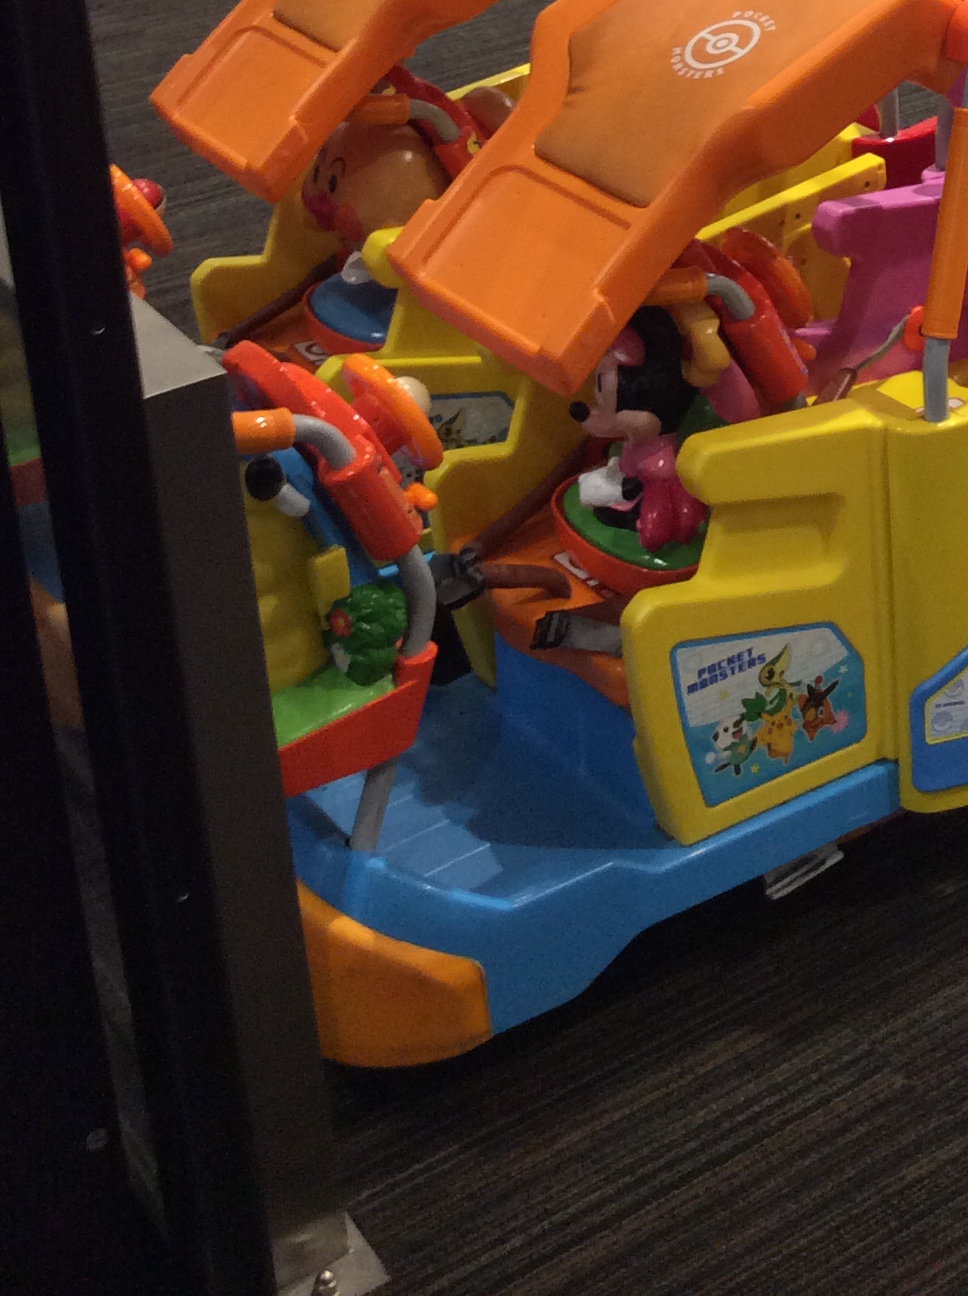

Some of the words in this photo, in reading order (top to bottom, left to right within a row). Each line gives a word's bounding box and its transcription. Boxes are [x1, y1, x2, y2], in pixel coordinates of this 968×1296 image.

[732, 10, 776, 32] POCKET
[670, 46, 725, 80] MONSTERS
[686, 653, 767, 696] MONSTERS
[697, 647, 754, 680] POCKET
